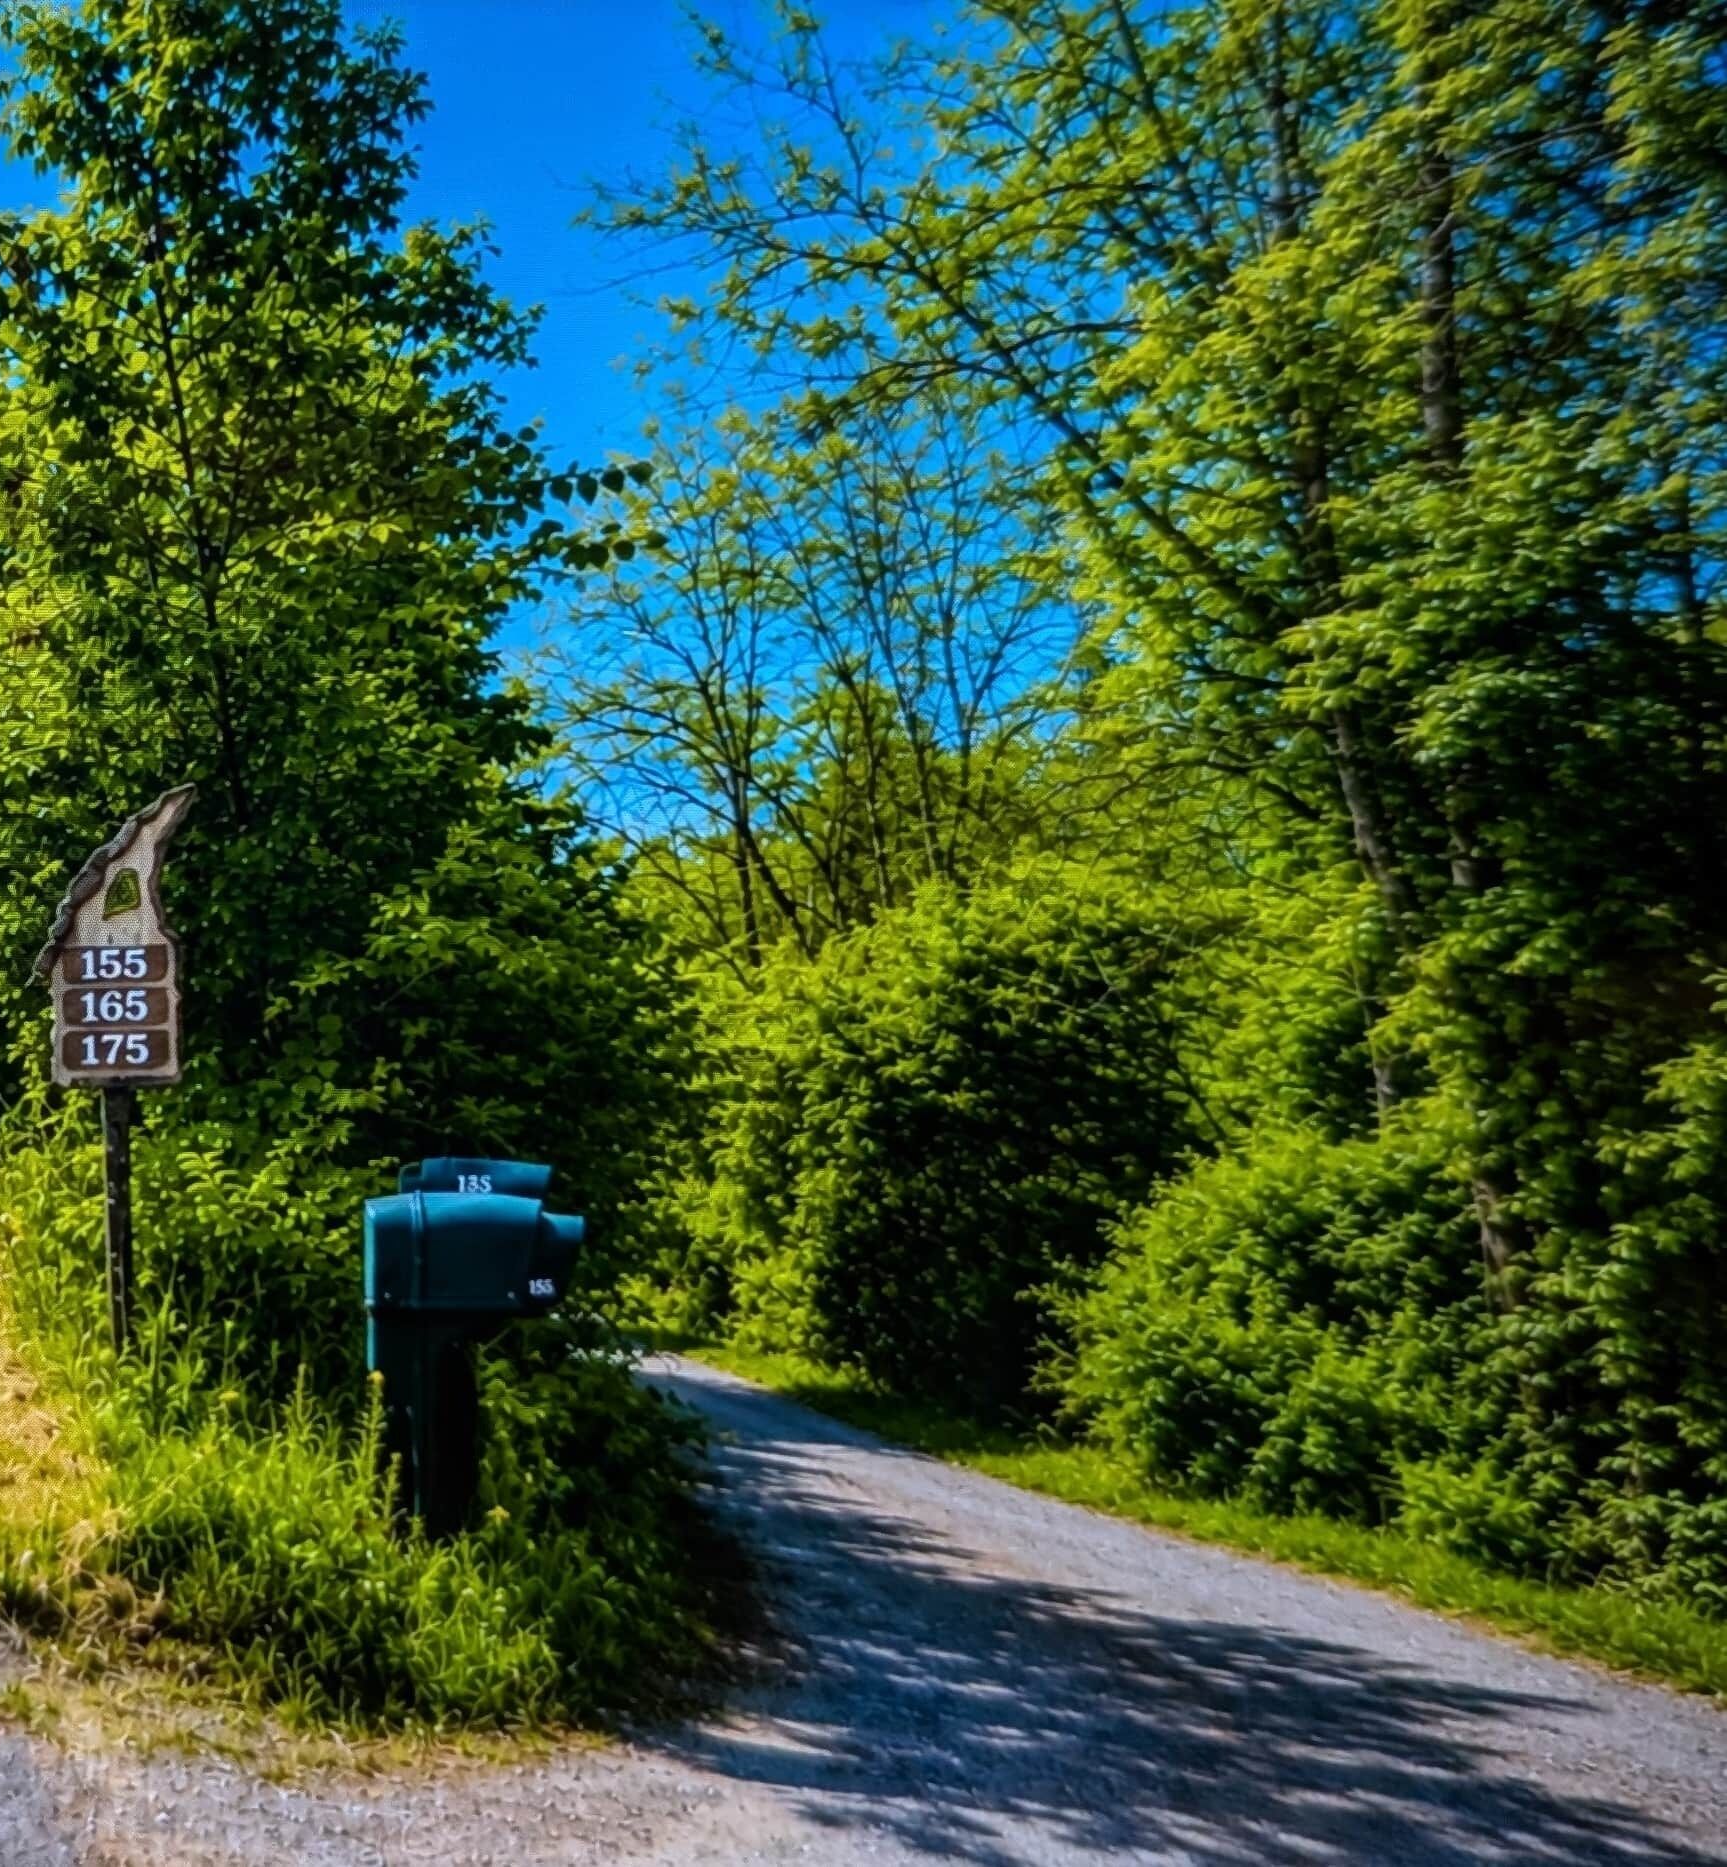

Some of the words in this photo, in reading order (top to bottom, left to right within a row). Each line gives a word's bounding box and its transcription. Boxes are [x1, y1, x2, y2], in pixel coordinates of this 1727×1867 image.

[80, 950, 147, 980] 155
[80, 990, 148, 1023] 165
[81, 1033, 149, 1065] 175
